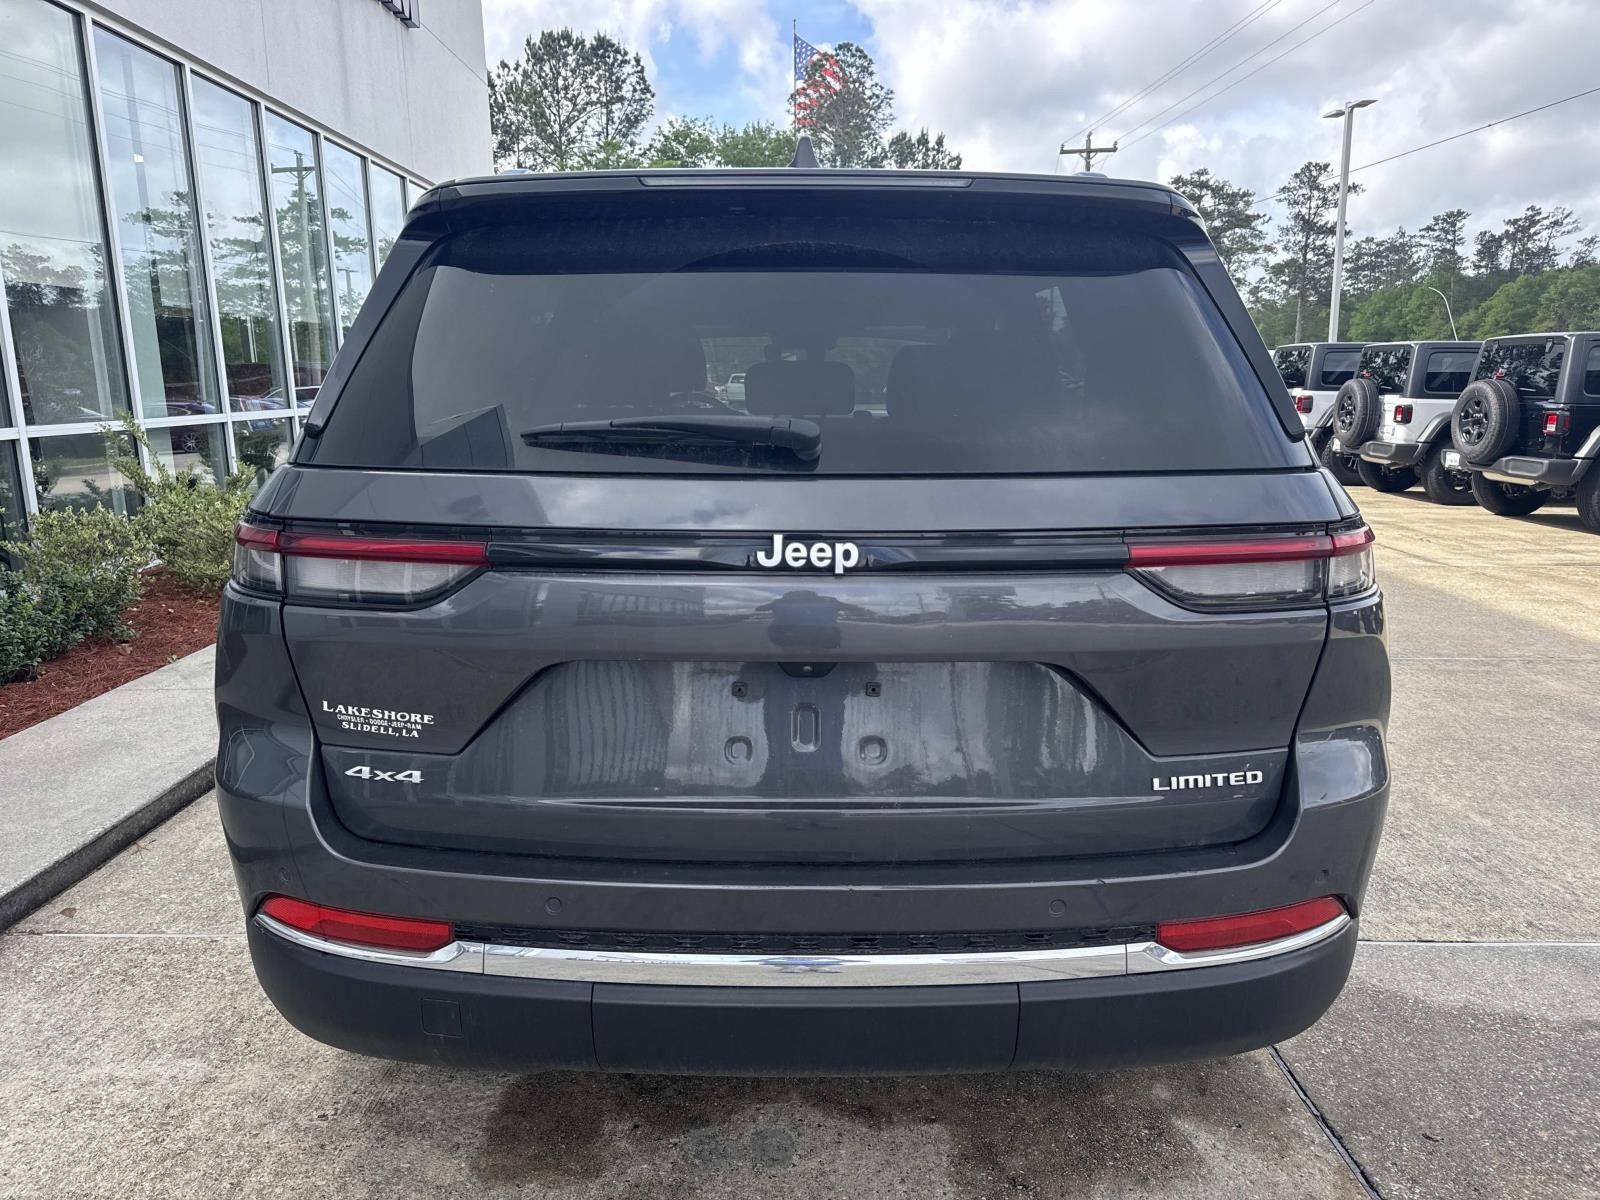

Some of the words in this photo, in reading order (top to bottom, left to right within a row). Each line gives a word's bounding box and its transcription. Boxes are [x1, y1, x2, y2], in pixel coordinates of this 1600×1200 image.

[756, 534, 859, 574] Jeep
[322, 700, 434, 725] LAKESHORE
[341, 721, 400, 737] SLIDELL,
[402, 728, 419, 738] LA
[344, 765, 425, 784] 4x4
[1152, 771, 1263, 791] LIMITED
